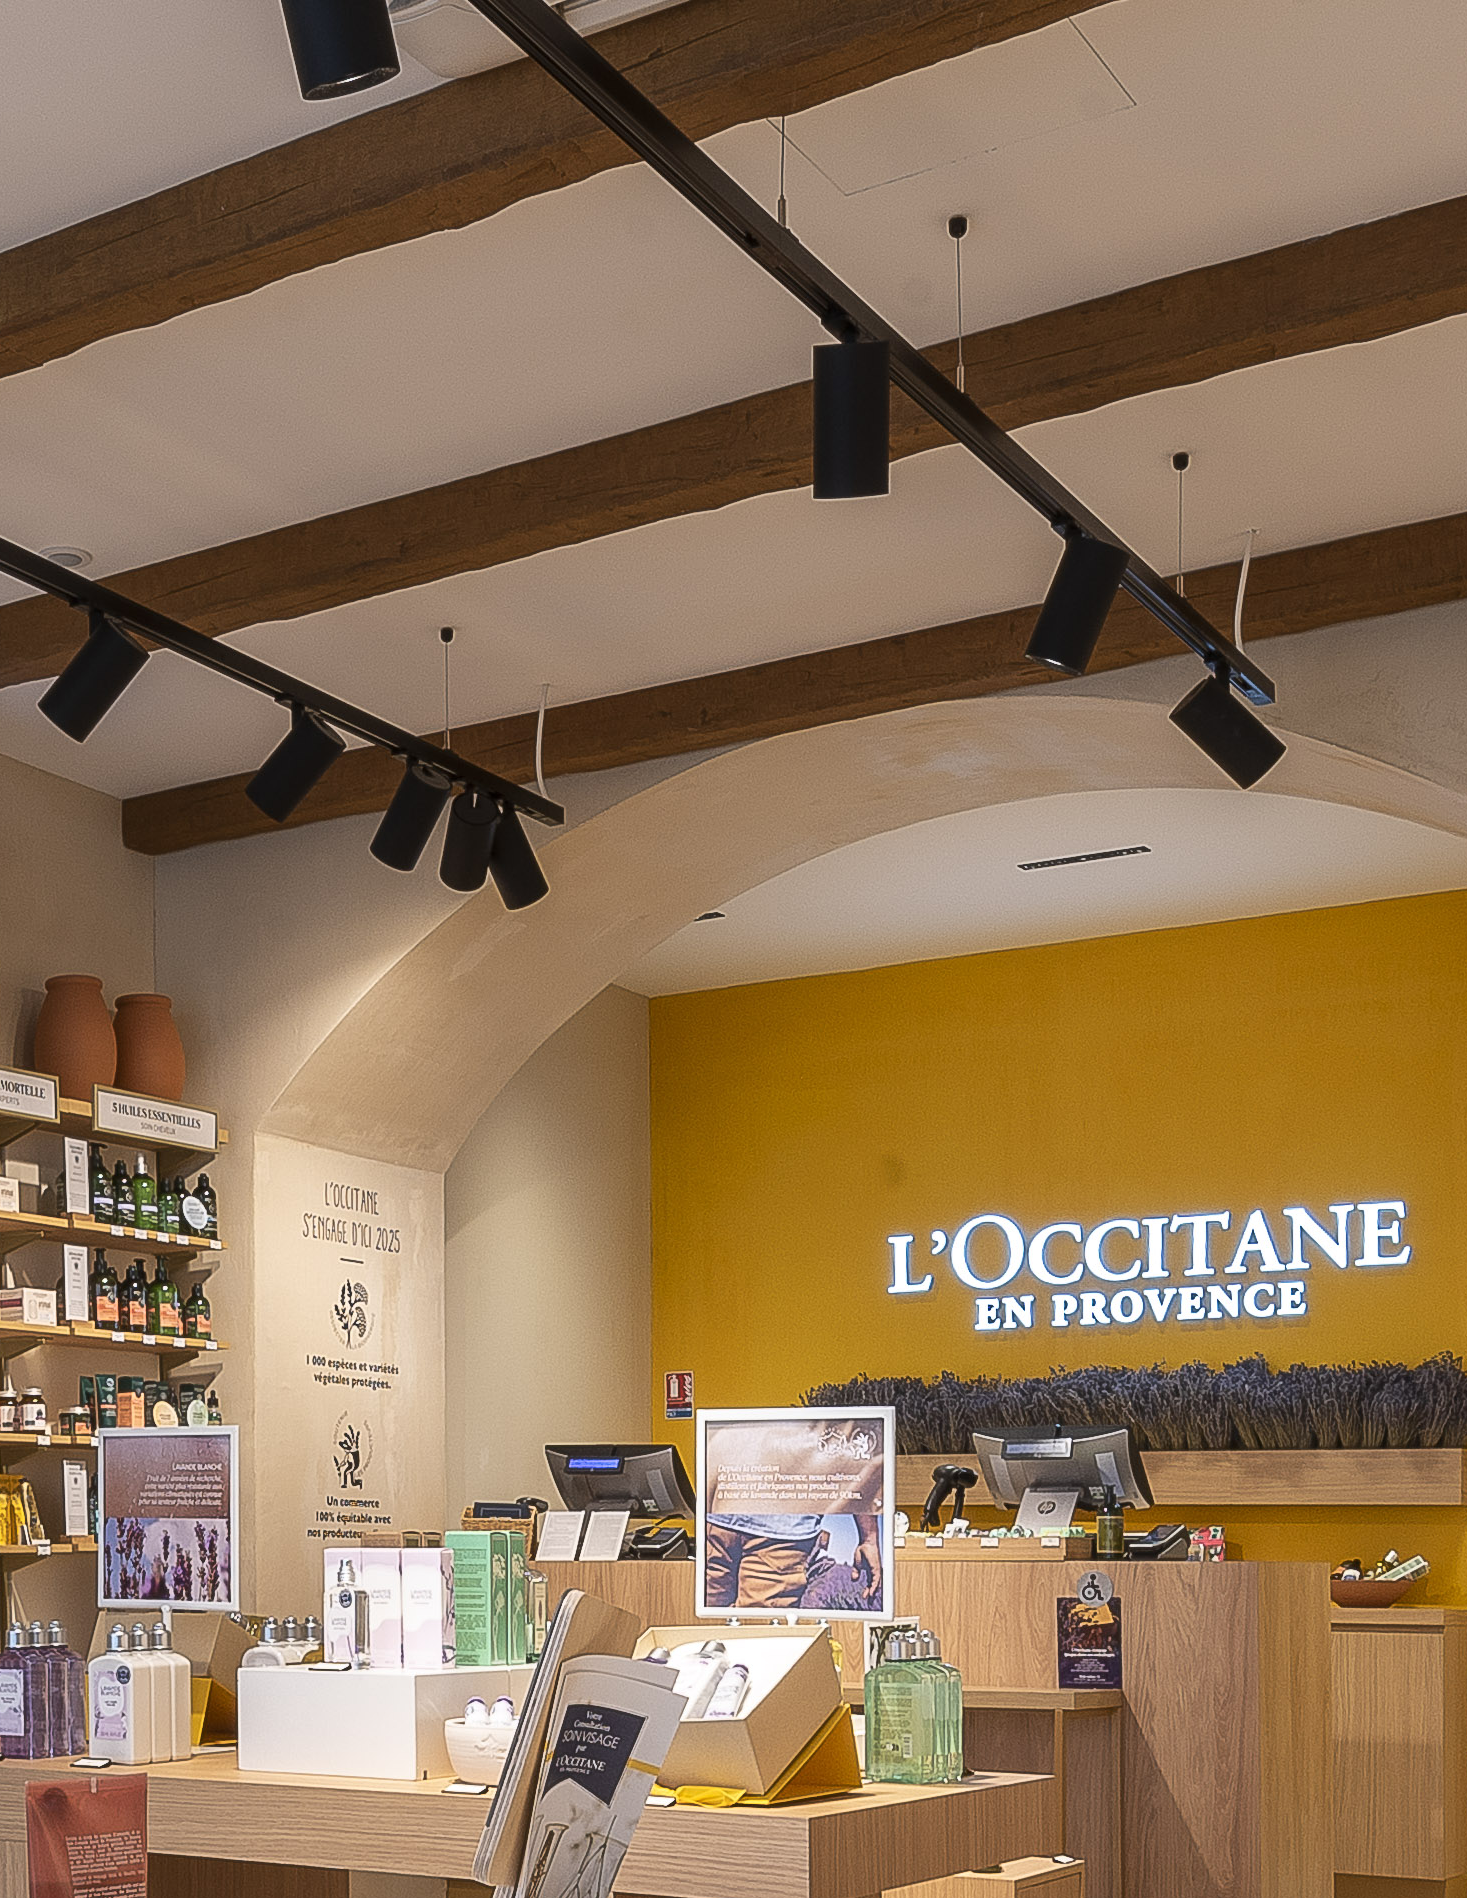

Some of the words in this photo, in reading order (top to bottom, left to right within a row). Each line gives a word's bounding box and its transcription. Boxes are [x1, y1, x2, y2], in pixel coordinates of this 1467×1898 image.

[112, 1102, 118, 1112] 5
[118, 1103, 147, 1118] HUILES
[147, 1109, 201, 1130] ESSENTIELLES
[325, 1181, 379, 1215] L'OCCITANE
[303, 1212, 348, 1244] S'ENGAGE
[351, 1221, 371, 1248] D'ICI
[376, 1227, 400, 1253] 2025
[886, 1200, 1412, 1295] L'OCCITANE
[974, 1294, 1036, 1332] EN
[1050, 1281, 1308, 1327] PROVENCE
[312, 1355, 326, 1366] 000
[328, 1358, 357, 1371] espèces
[358, 1362, 368, 1372] et
[369, 1363, 399, 1375] variétés
[314, 1371, 350, 1386] végétales
[351, 1376, 392, 1391] protégées.
[327, 1496, 338, 1506] Un
[340, 1497, 380, 1508] commerce
[316, 1511, 334, 1522] 100%
[337, 1512, 373, 1525] équitable
[374, 1515, 391, 1524] avec
[556, 1754, 606, 1771] L'OCCITANE
